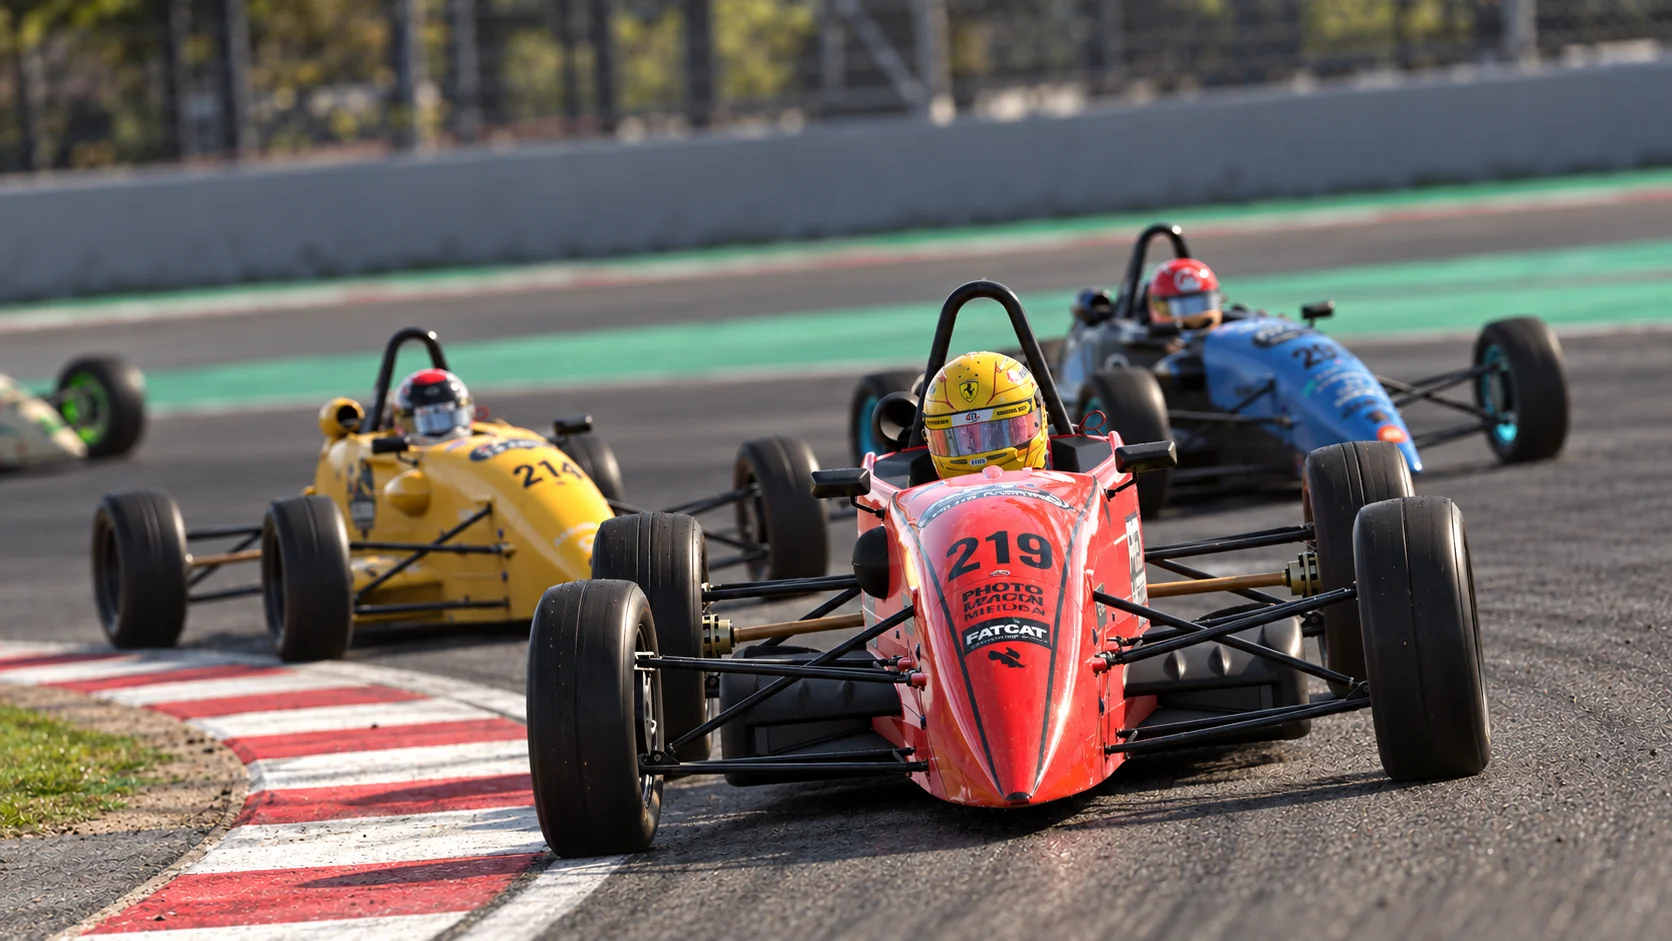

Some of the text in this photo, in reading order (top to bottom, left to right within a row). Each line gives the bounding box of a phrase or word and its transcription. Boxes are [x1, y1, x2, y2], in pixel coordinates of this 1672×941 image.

[513, 460, 583, 489] 214
[945, 530, 1053, 582] 219
[962, 582, 1044, 602] PHOTO
[966, 624, 1047, 645] FATCAT
